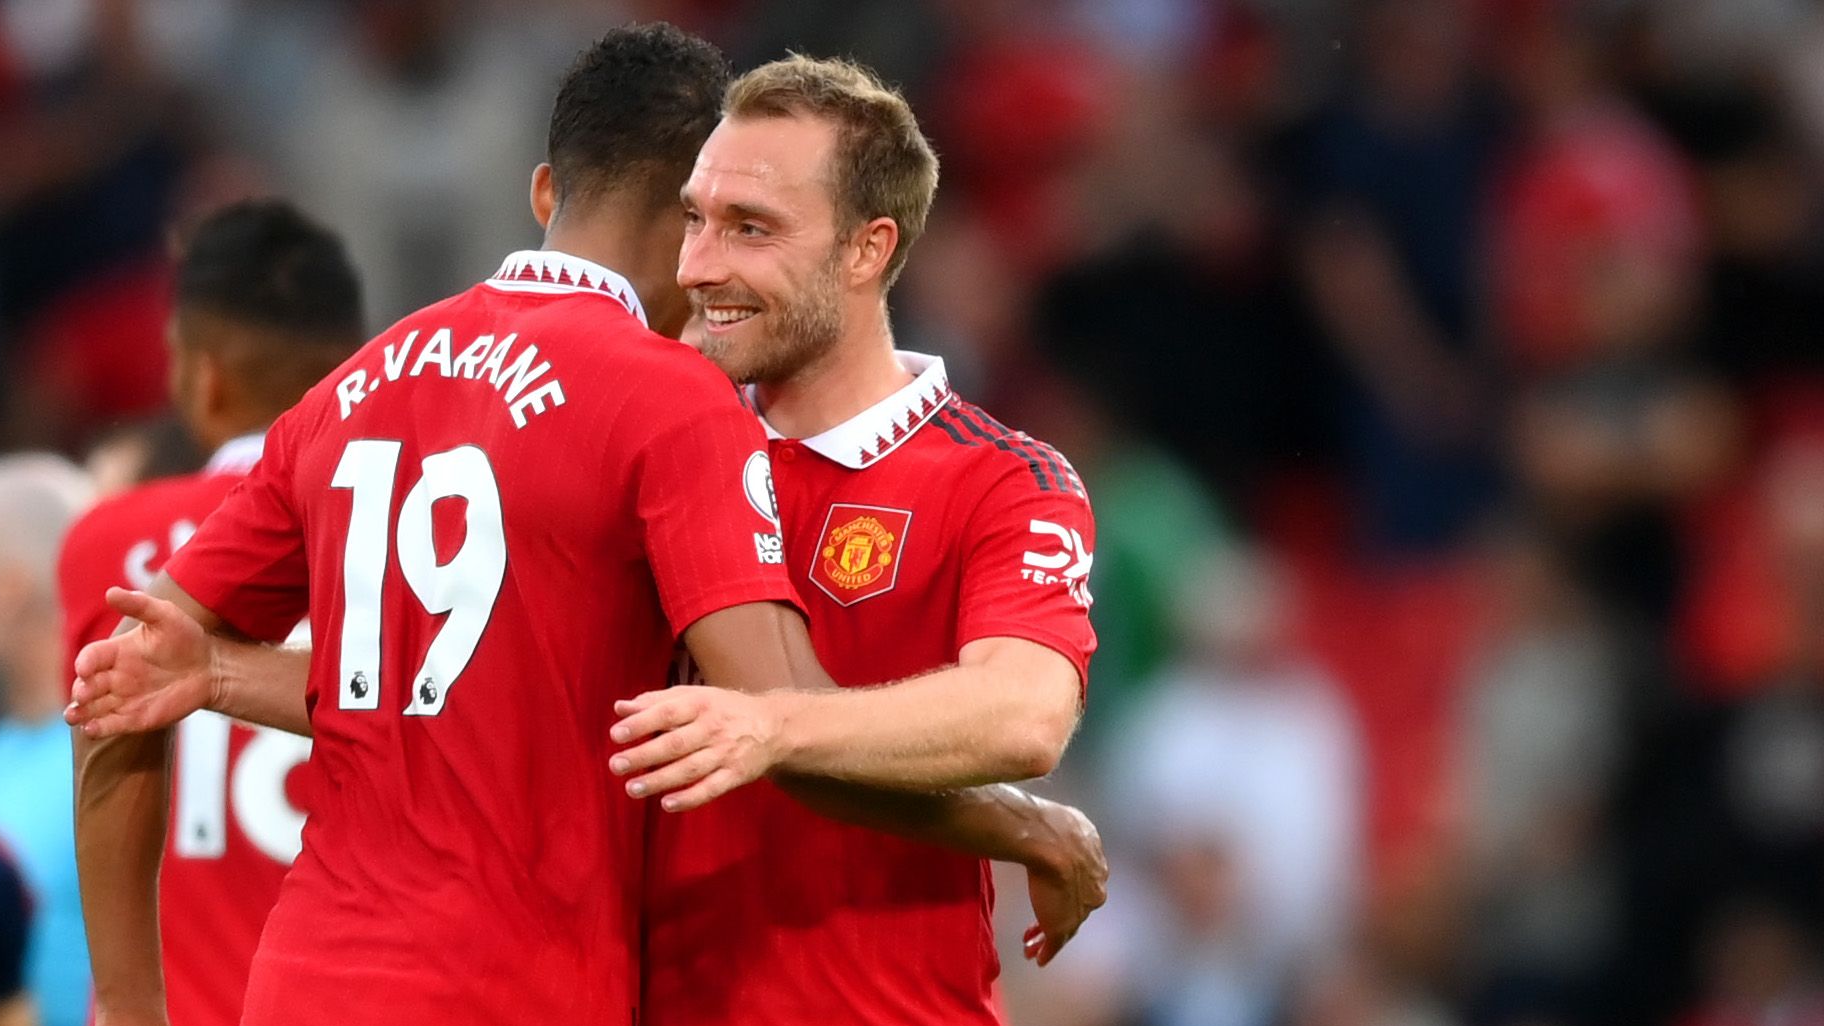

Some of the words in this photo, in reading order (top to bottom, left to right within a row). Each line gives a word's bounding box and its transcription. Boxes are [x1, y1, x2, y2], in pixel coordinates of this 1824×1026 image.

[336, 327, 566, 430] R.VARANE
[329, 438, 508, 717] 19
[831, 568, 872, 584] UNITED
